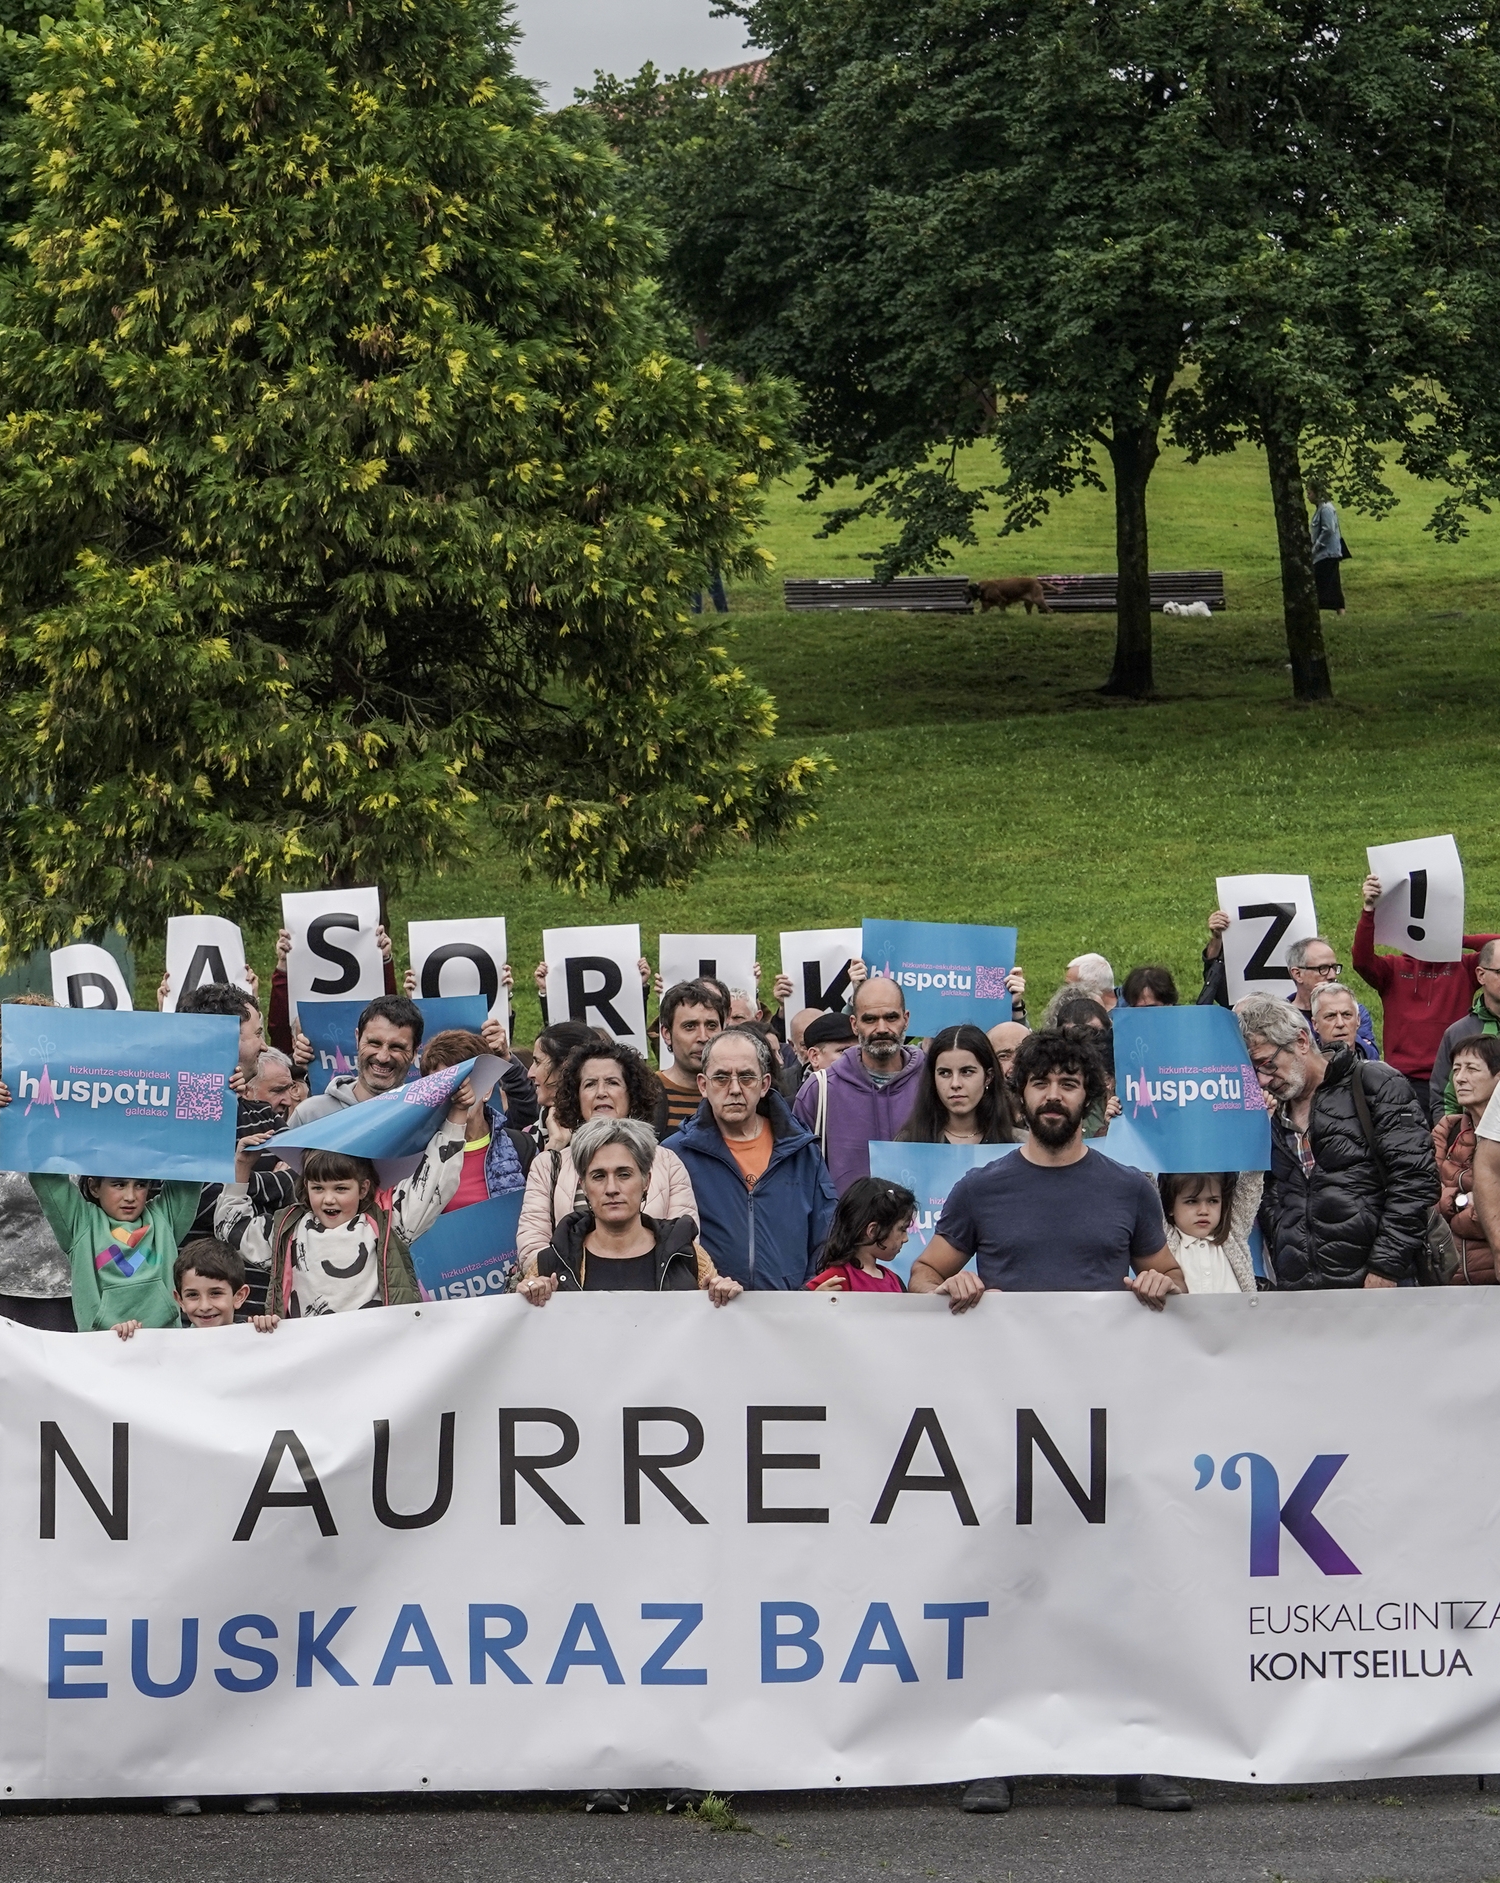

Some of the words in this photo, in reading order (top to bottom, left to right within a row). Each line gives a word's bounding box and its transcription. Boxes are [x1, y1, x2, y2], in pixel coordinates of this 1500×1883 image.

[1406, 868, 1428, 942] !
[306, 912, 361, 995] S
[420, 942, 498, 1014] O
[1238, 902, 1298, 982] Z
[564, 955, 636, 1037] R
[803, 958, 852, 1013] K
[69, 1065, 171, 1080] hizkuntza-eskubideak
[125, 1107, 169, 1117] galdakao
[441, 1249, 518, 1279] hizkuntza-eskubide
[231, 1405, 1107, 1542] AURREAN
[48, 1603, 707, 1699] EUSKARAZ
[760, 1601, 989, 1684] BAT
[1250, 1649, 1473, 1682] KONTSEILUA
